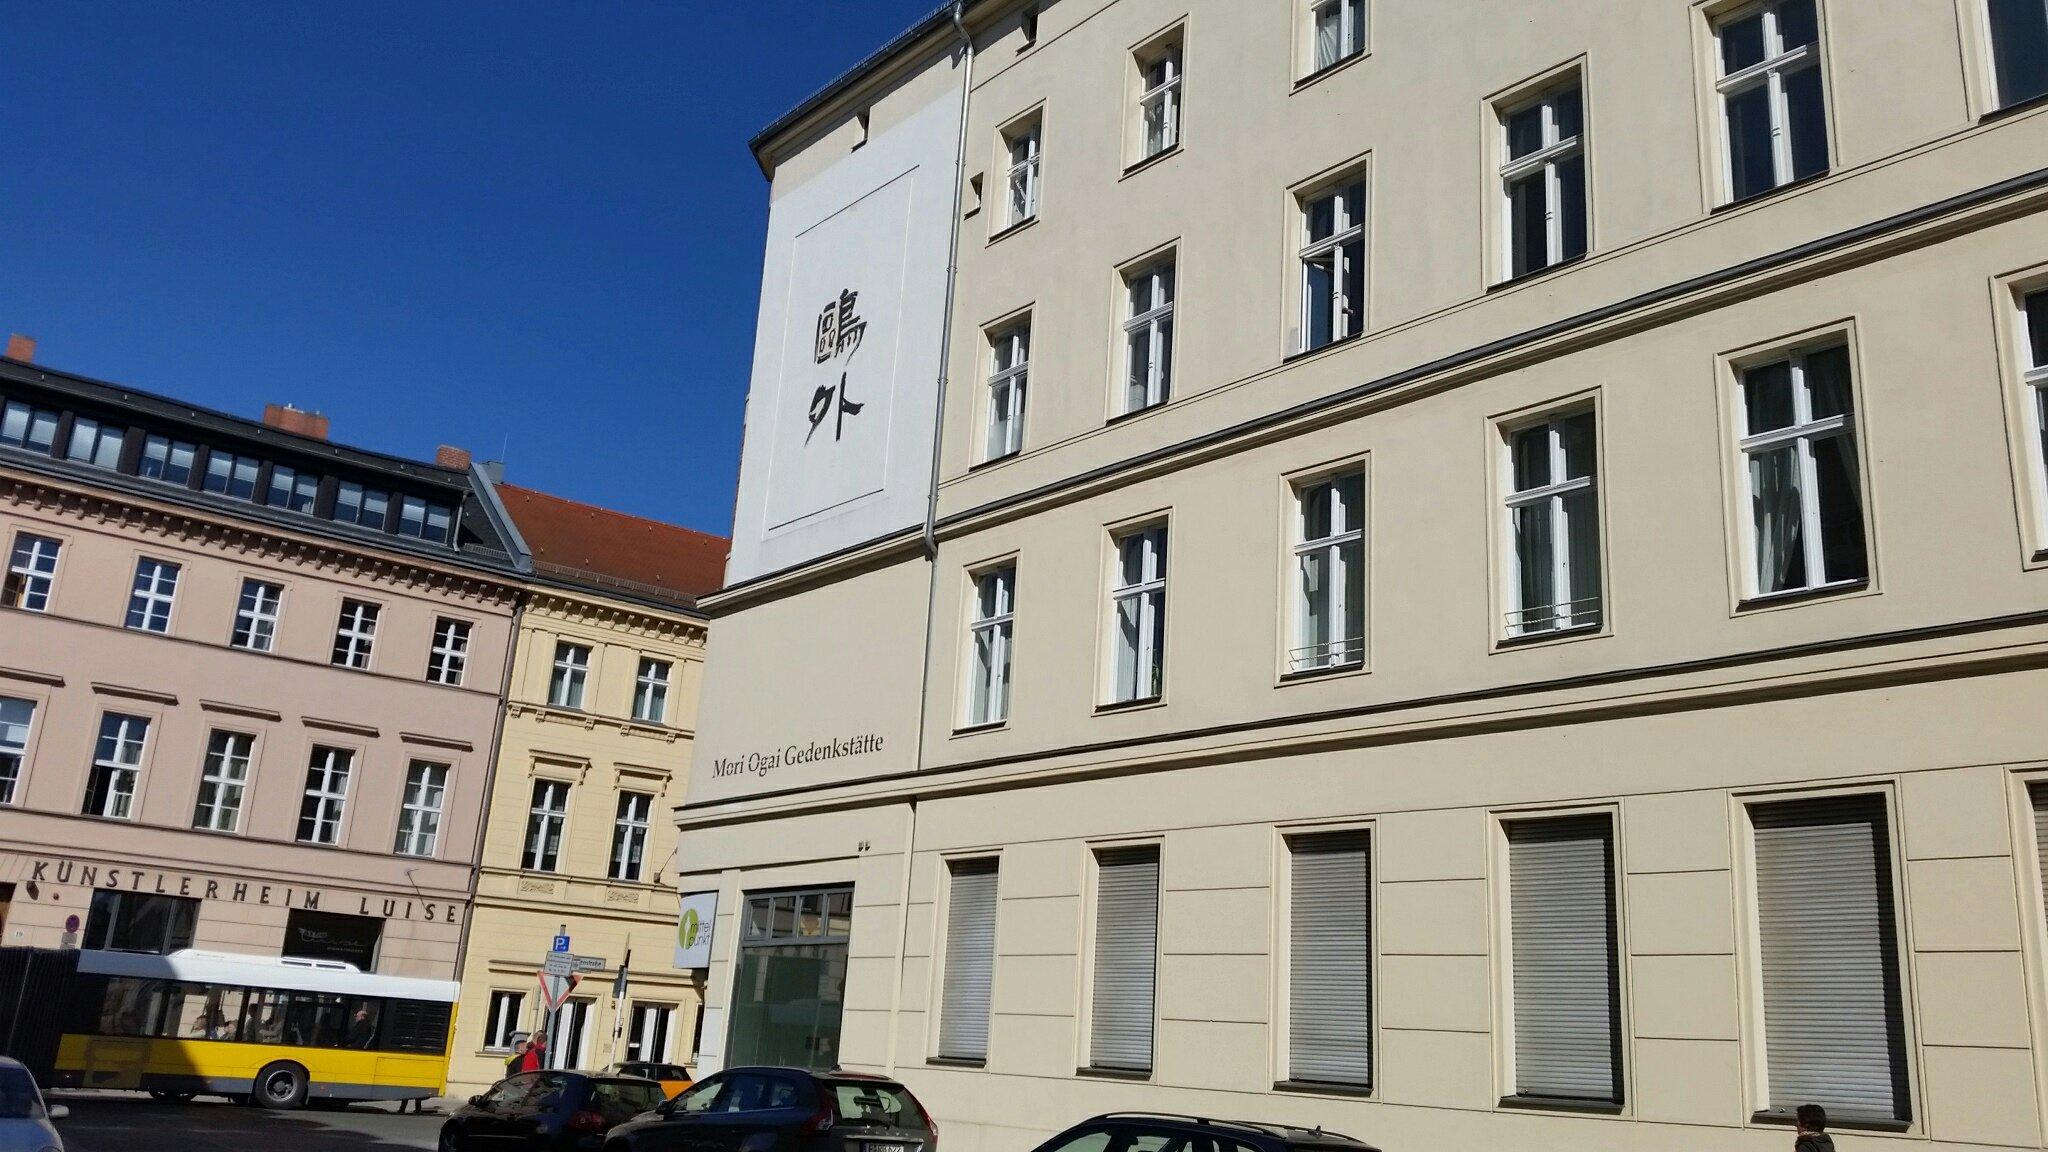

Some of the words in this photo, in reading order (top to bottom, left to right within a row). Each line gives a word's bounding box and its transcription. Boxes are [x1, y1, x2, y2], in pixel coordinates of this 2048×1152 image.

[712, 755, 745, 778] Mori
[748, 748, 781, 777] Ogai
[785, 733, 884, 765] Gedenkstätte
[31, 860, 320, 910] KÜNSTLERHEIM
[358, 896, 457, 923] LUISE
